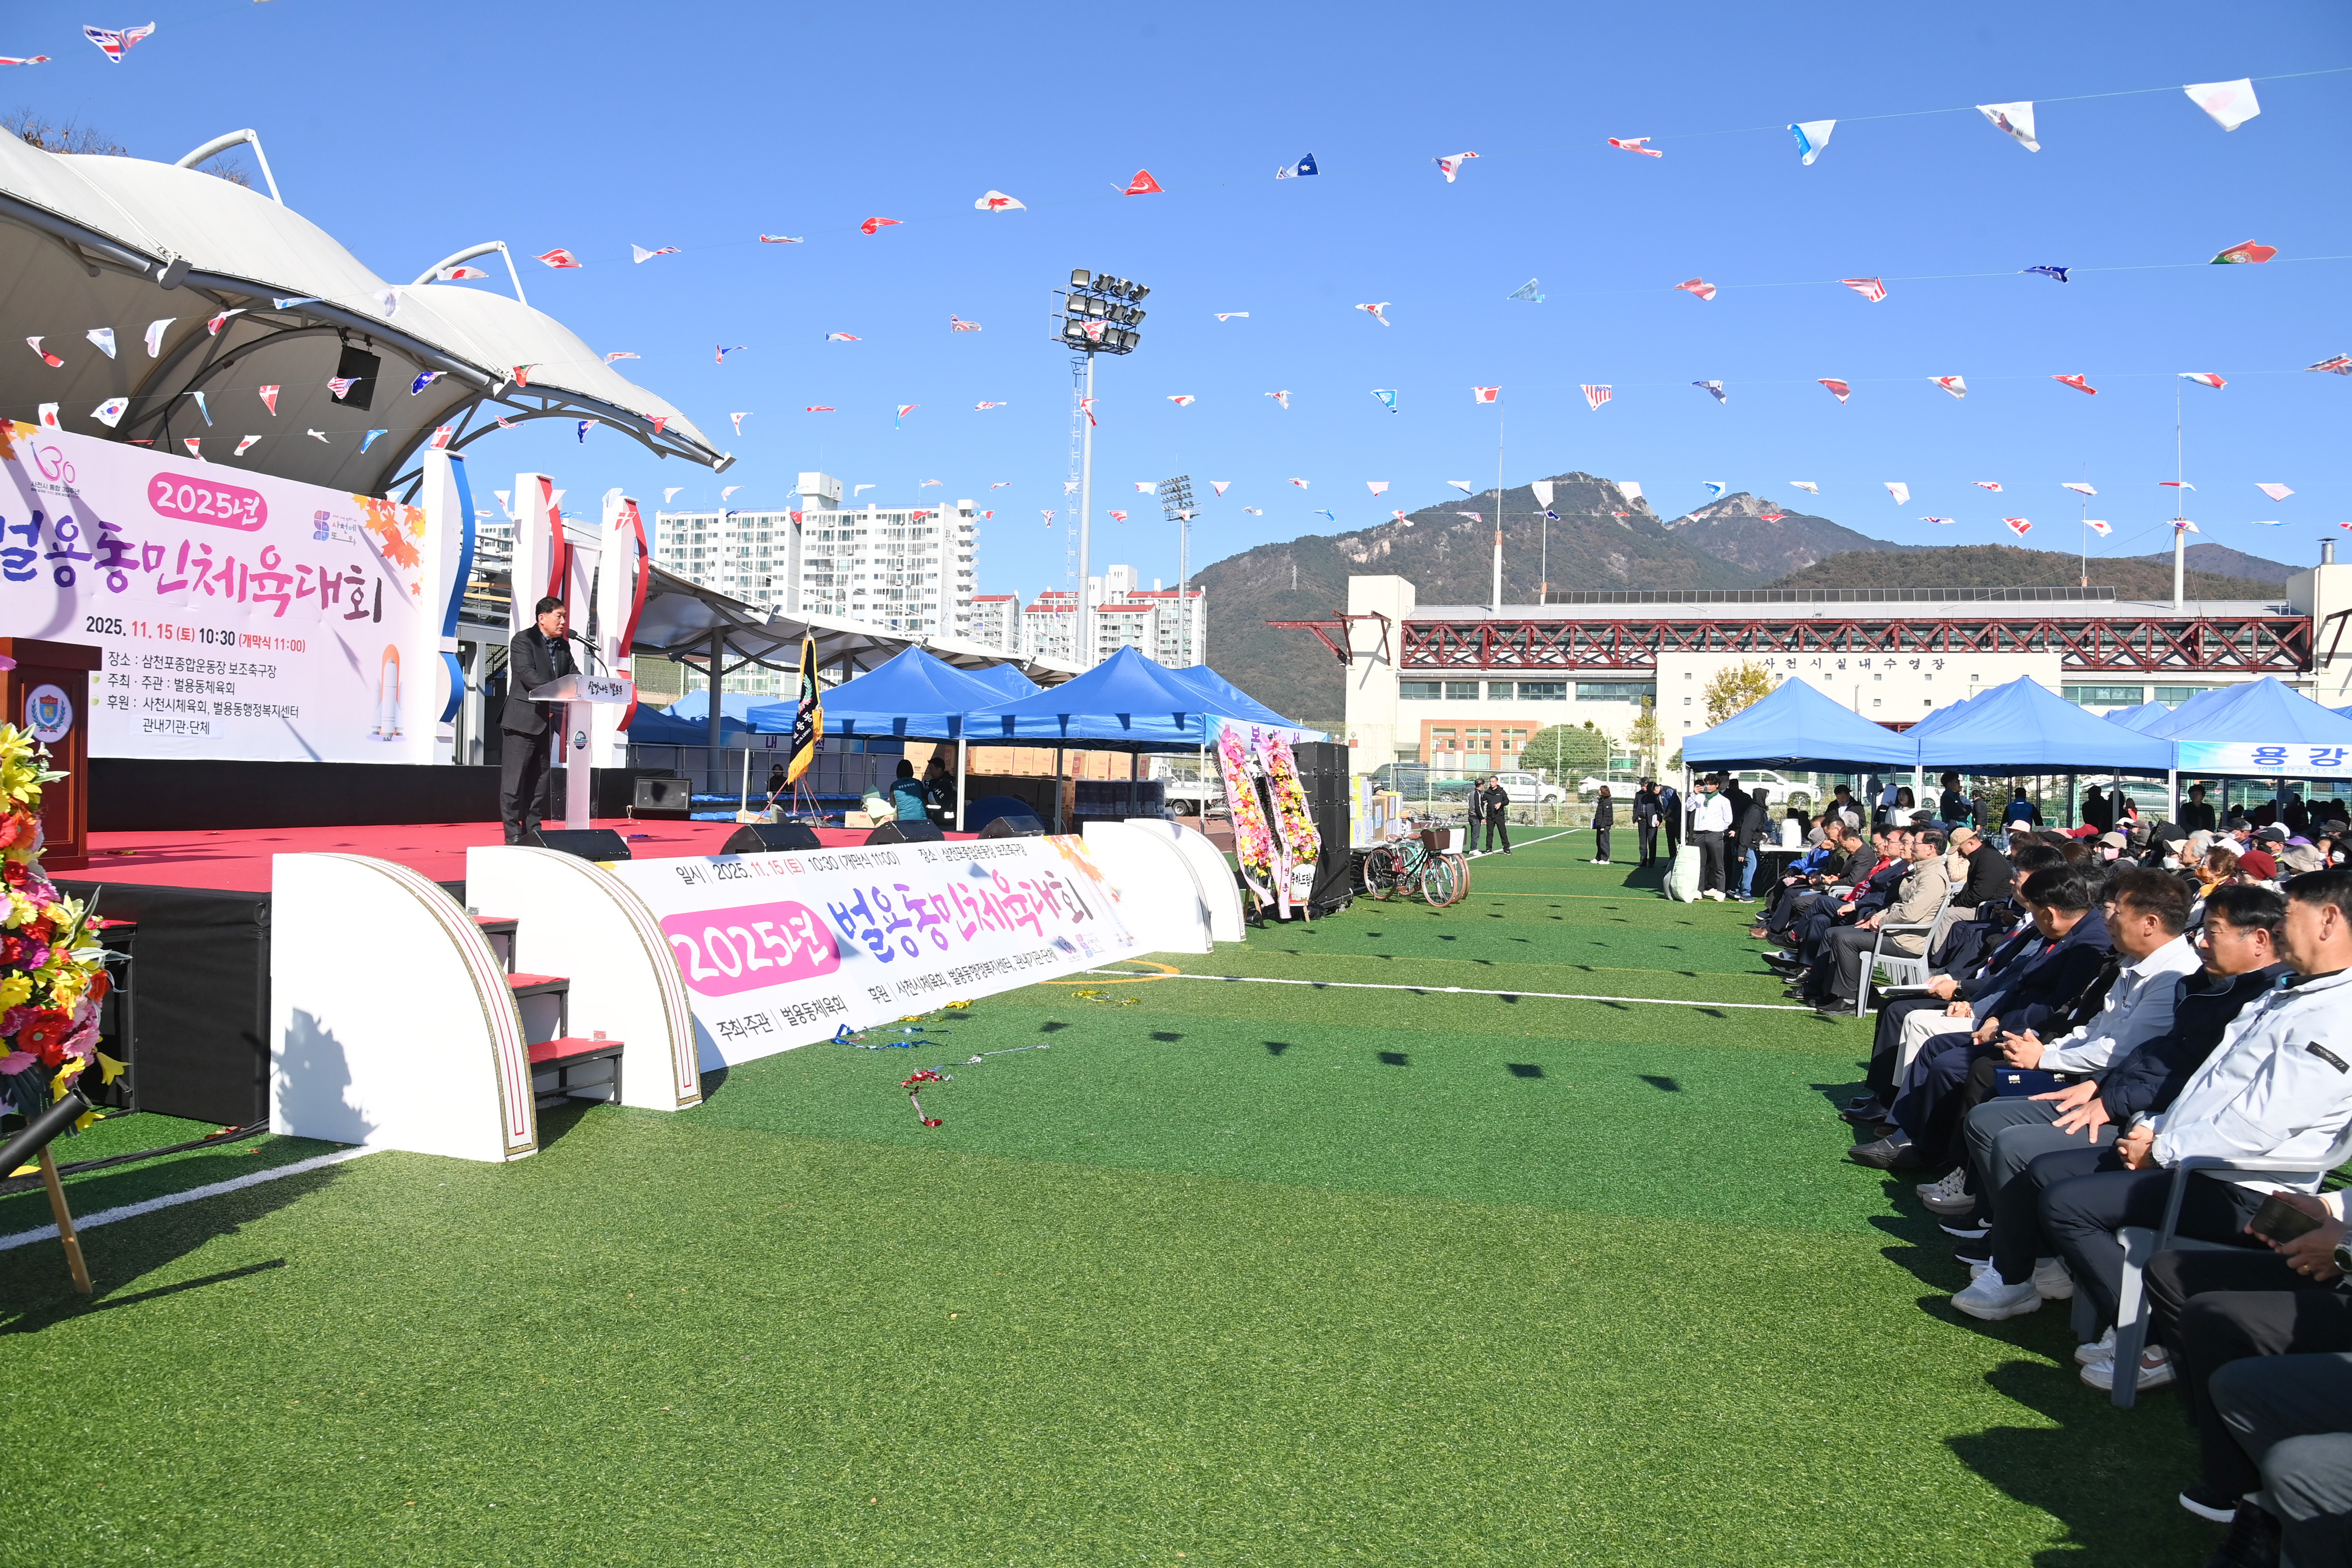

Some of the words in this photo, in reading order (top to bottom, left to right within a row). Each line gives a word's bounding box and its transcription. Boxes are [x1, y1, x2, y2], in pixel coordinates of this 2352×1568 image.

[157, 481, 261, 525] 2025년
[86, 616, 127, 636] 2025.
[132, 621, 153, 639] 11.
[157, 623, 173, 640] 15
[176, 626, 195, 643] (토)
[199, 627, 235, 646] 10:30
[238, 633, 271, 649] (개막식
[274, 637, 306, 653] 11:00)
[108, 651, 131, 666] 장소
[141, 654, 226, 675] 삼천포종합운동장
[228, 661, 277, 679] 보조축구장
[108, 673, 130, 688] 주최
[141, 675, 163, 691] 주관
[174, 678, 235, 695] 벌용동체육회
[107, 694, 130, 710] 후원
[142, 697, 210, 716] 사천시체육회,
[213, 701, 299, 719] 벌용동행정복지센터
[142, 718, 210, 735] 관내기관·단체
[934, 788, 945, 800] HE
[676, 865, 706, 885] 일시
[712, 862, 752, 880] 2025.
[751, 861, 770, 876] 11.
[768, 859, 784, 875] 15
[783, 857, 805, 874] (토)
[808, 856, 839, 871] 10:30
[840, 852, 872, 870] (개막식
[870, 850, 901, 866] 11:00)
[918, 848, 938, 863] 장소
[941, 845, 996, 862] 삼천포종합운동장
[994, 843, 1027, 856] 보조축구장
[674, 910, 830, 982] 2025년
[827, 869, 1094, 964] 벌용동민체육대회
[867, 983, 892, 1005] 후원
[897, 971, 952, 997] 사천시체육회,
[947, 956, 1018, 986] 벌용동행정복지센터,
[1012, 947, 1059, 970] 관내기관·단체
[779, 994, 849, 1026] 벌용동체육회
